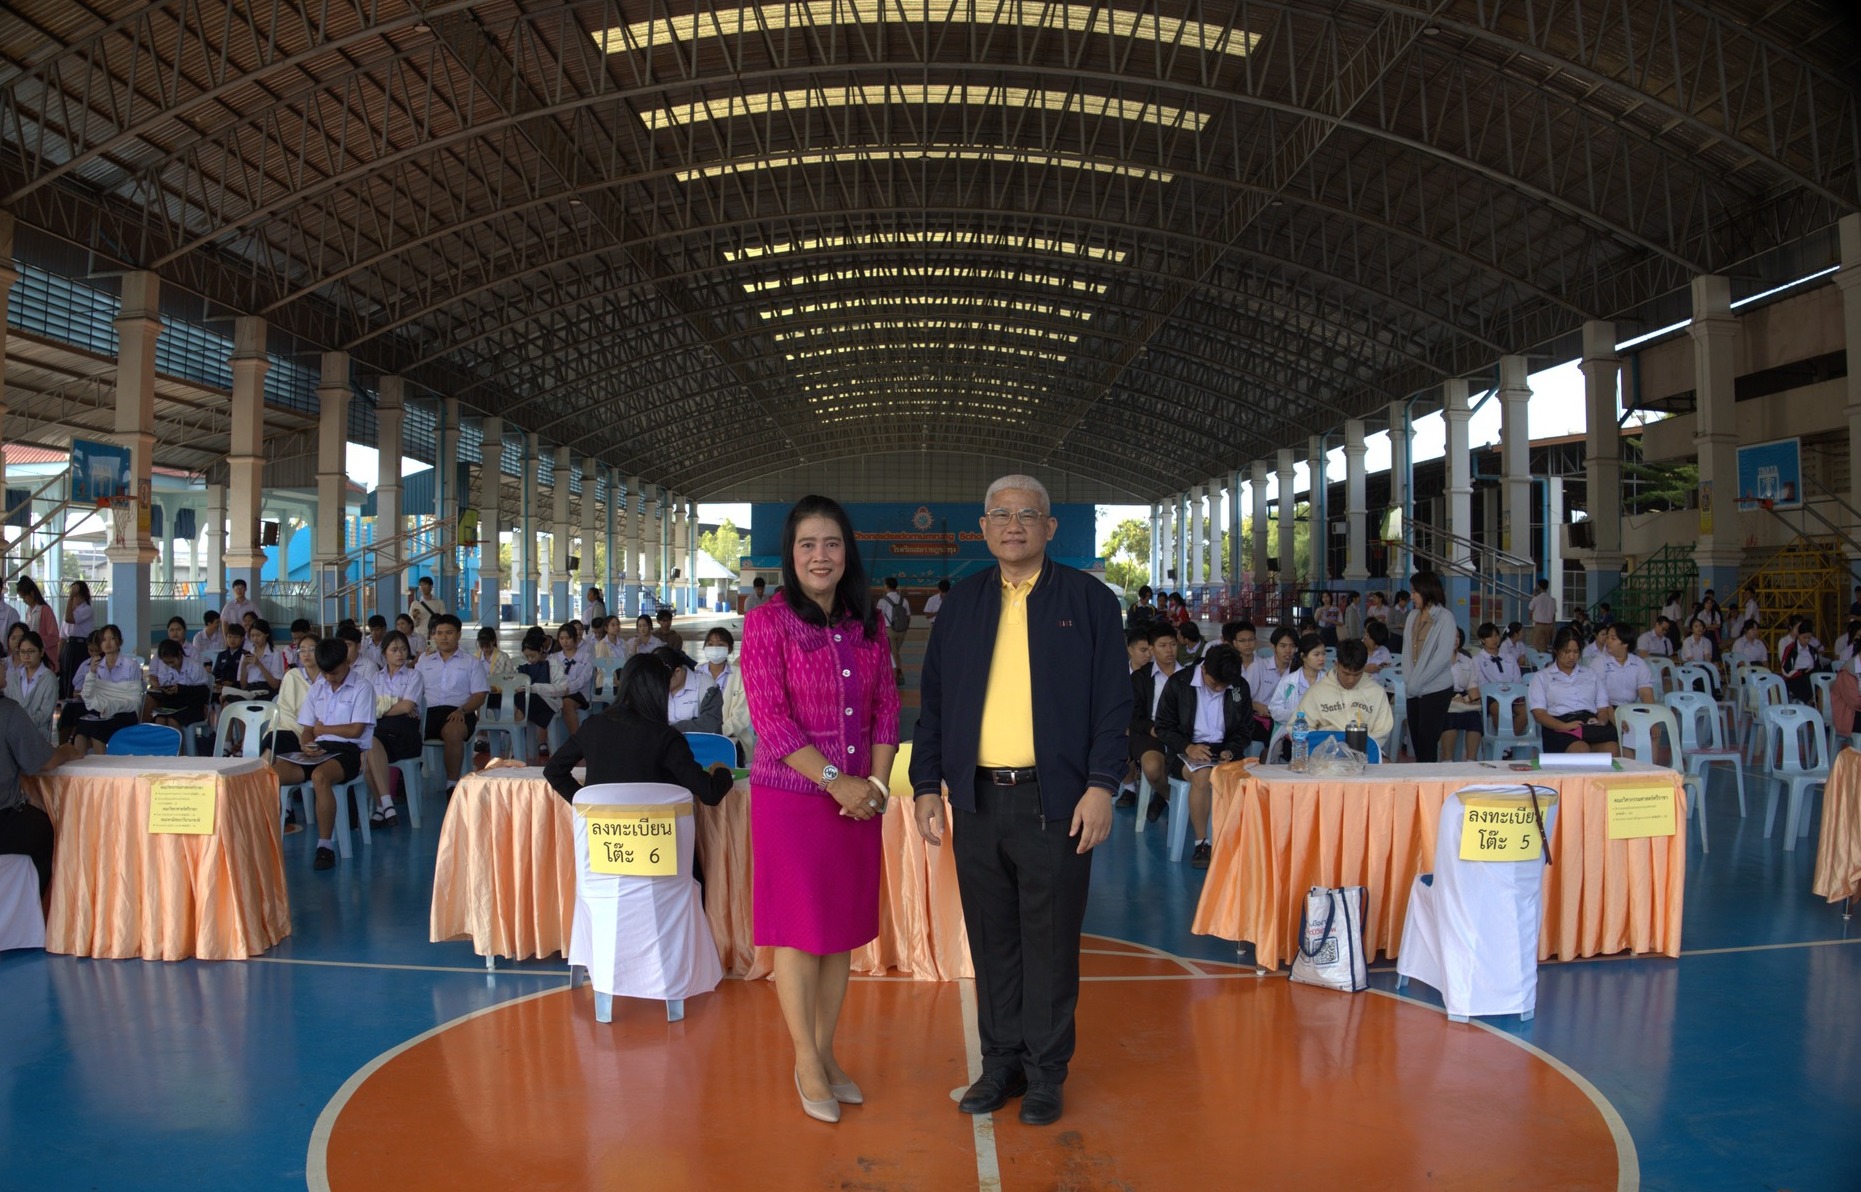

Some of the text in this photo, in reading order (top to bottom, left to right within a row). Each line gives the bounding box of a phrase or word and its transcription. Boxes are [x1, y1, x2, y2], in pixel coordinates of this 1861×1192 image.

[959, 531, 985, 541] Scho
[1469, 806, 1544, 824] ลงทะเบีย
[592, 817, 672, 837] ลงทะเบียน
[1478, 829, 1530, 850] โต๊ะ 5
[603, 841, 660, 864] โต๊ะ 6
